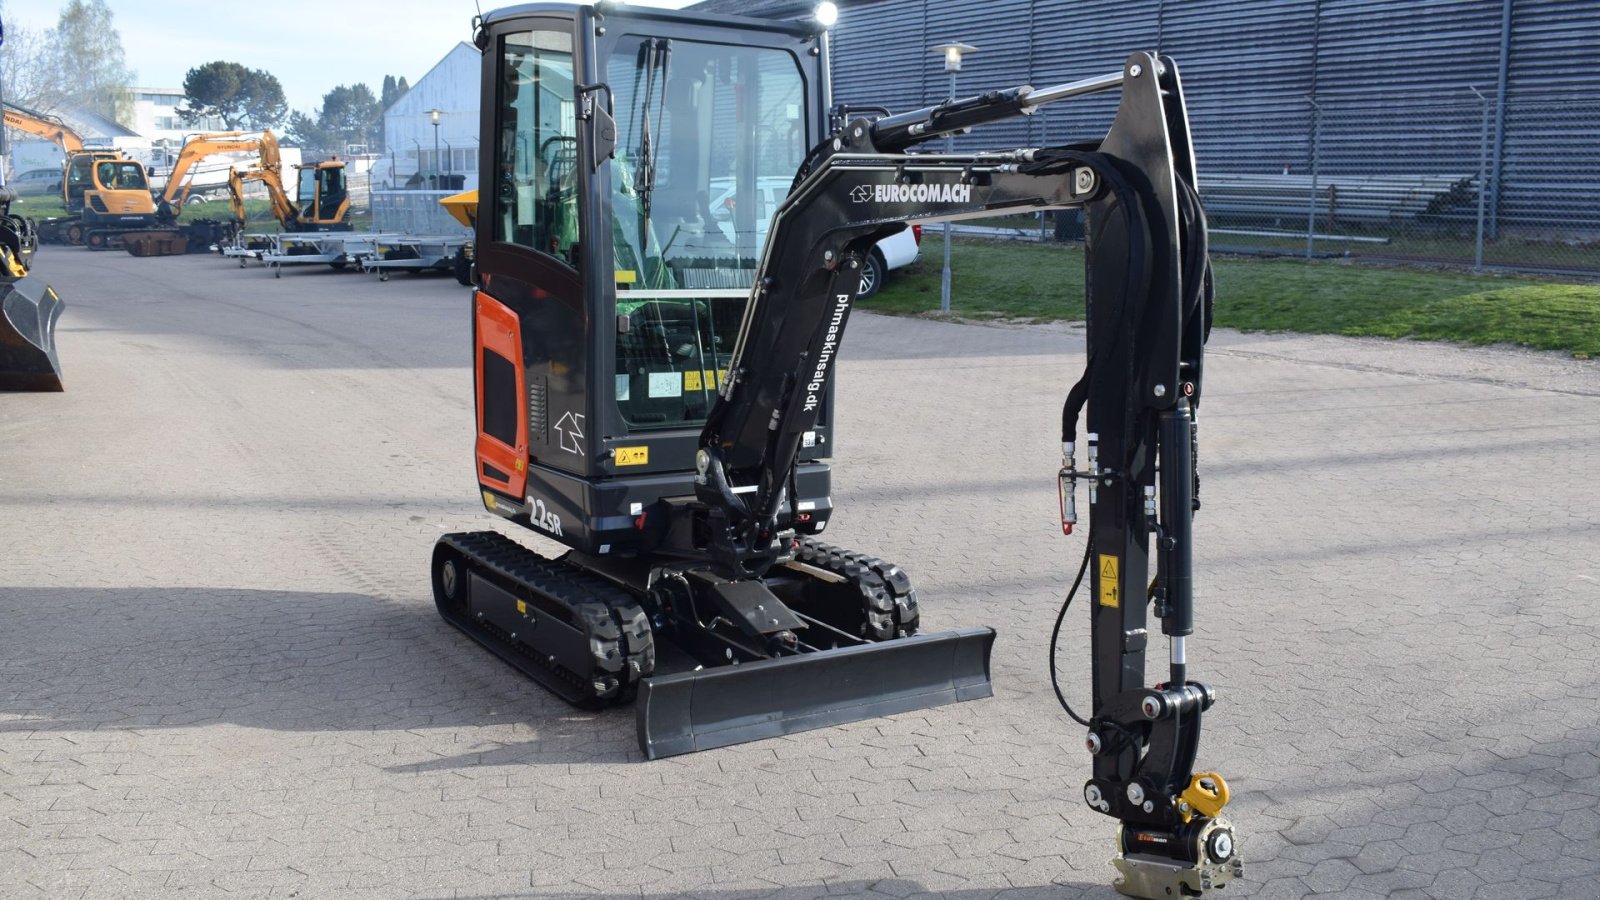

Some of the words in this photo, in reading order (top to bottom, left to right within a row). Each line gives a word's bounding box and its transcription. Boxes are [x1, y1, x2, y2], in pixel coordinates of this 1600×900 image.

[874, 184, 971, 203] EUROCOMACH
[803, 294, 849, 412] phmaskinsalg.dk
[527, 495, 563, 537] 22SR
